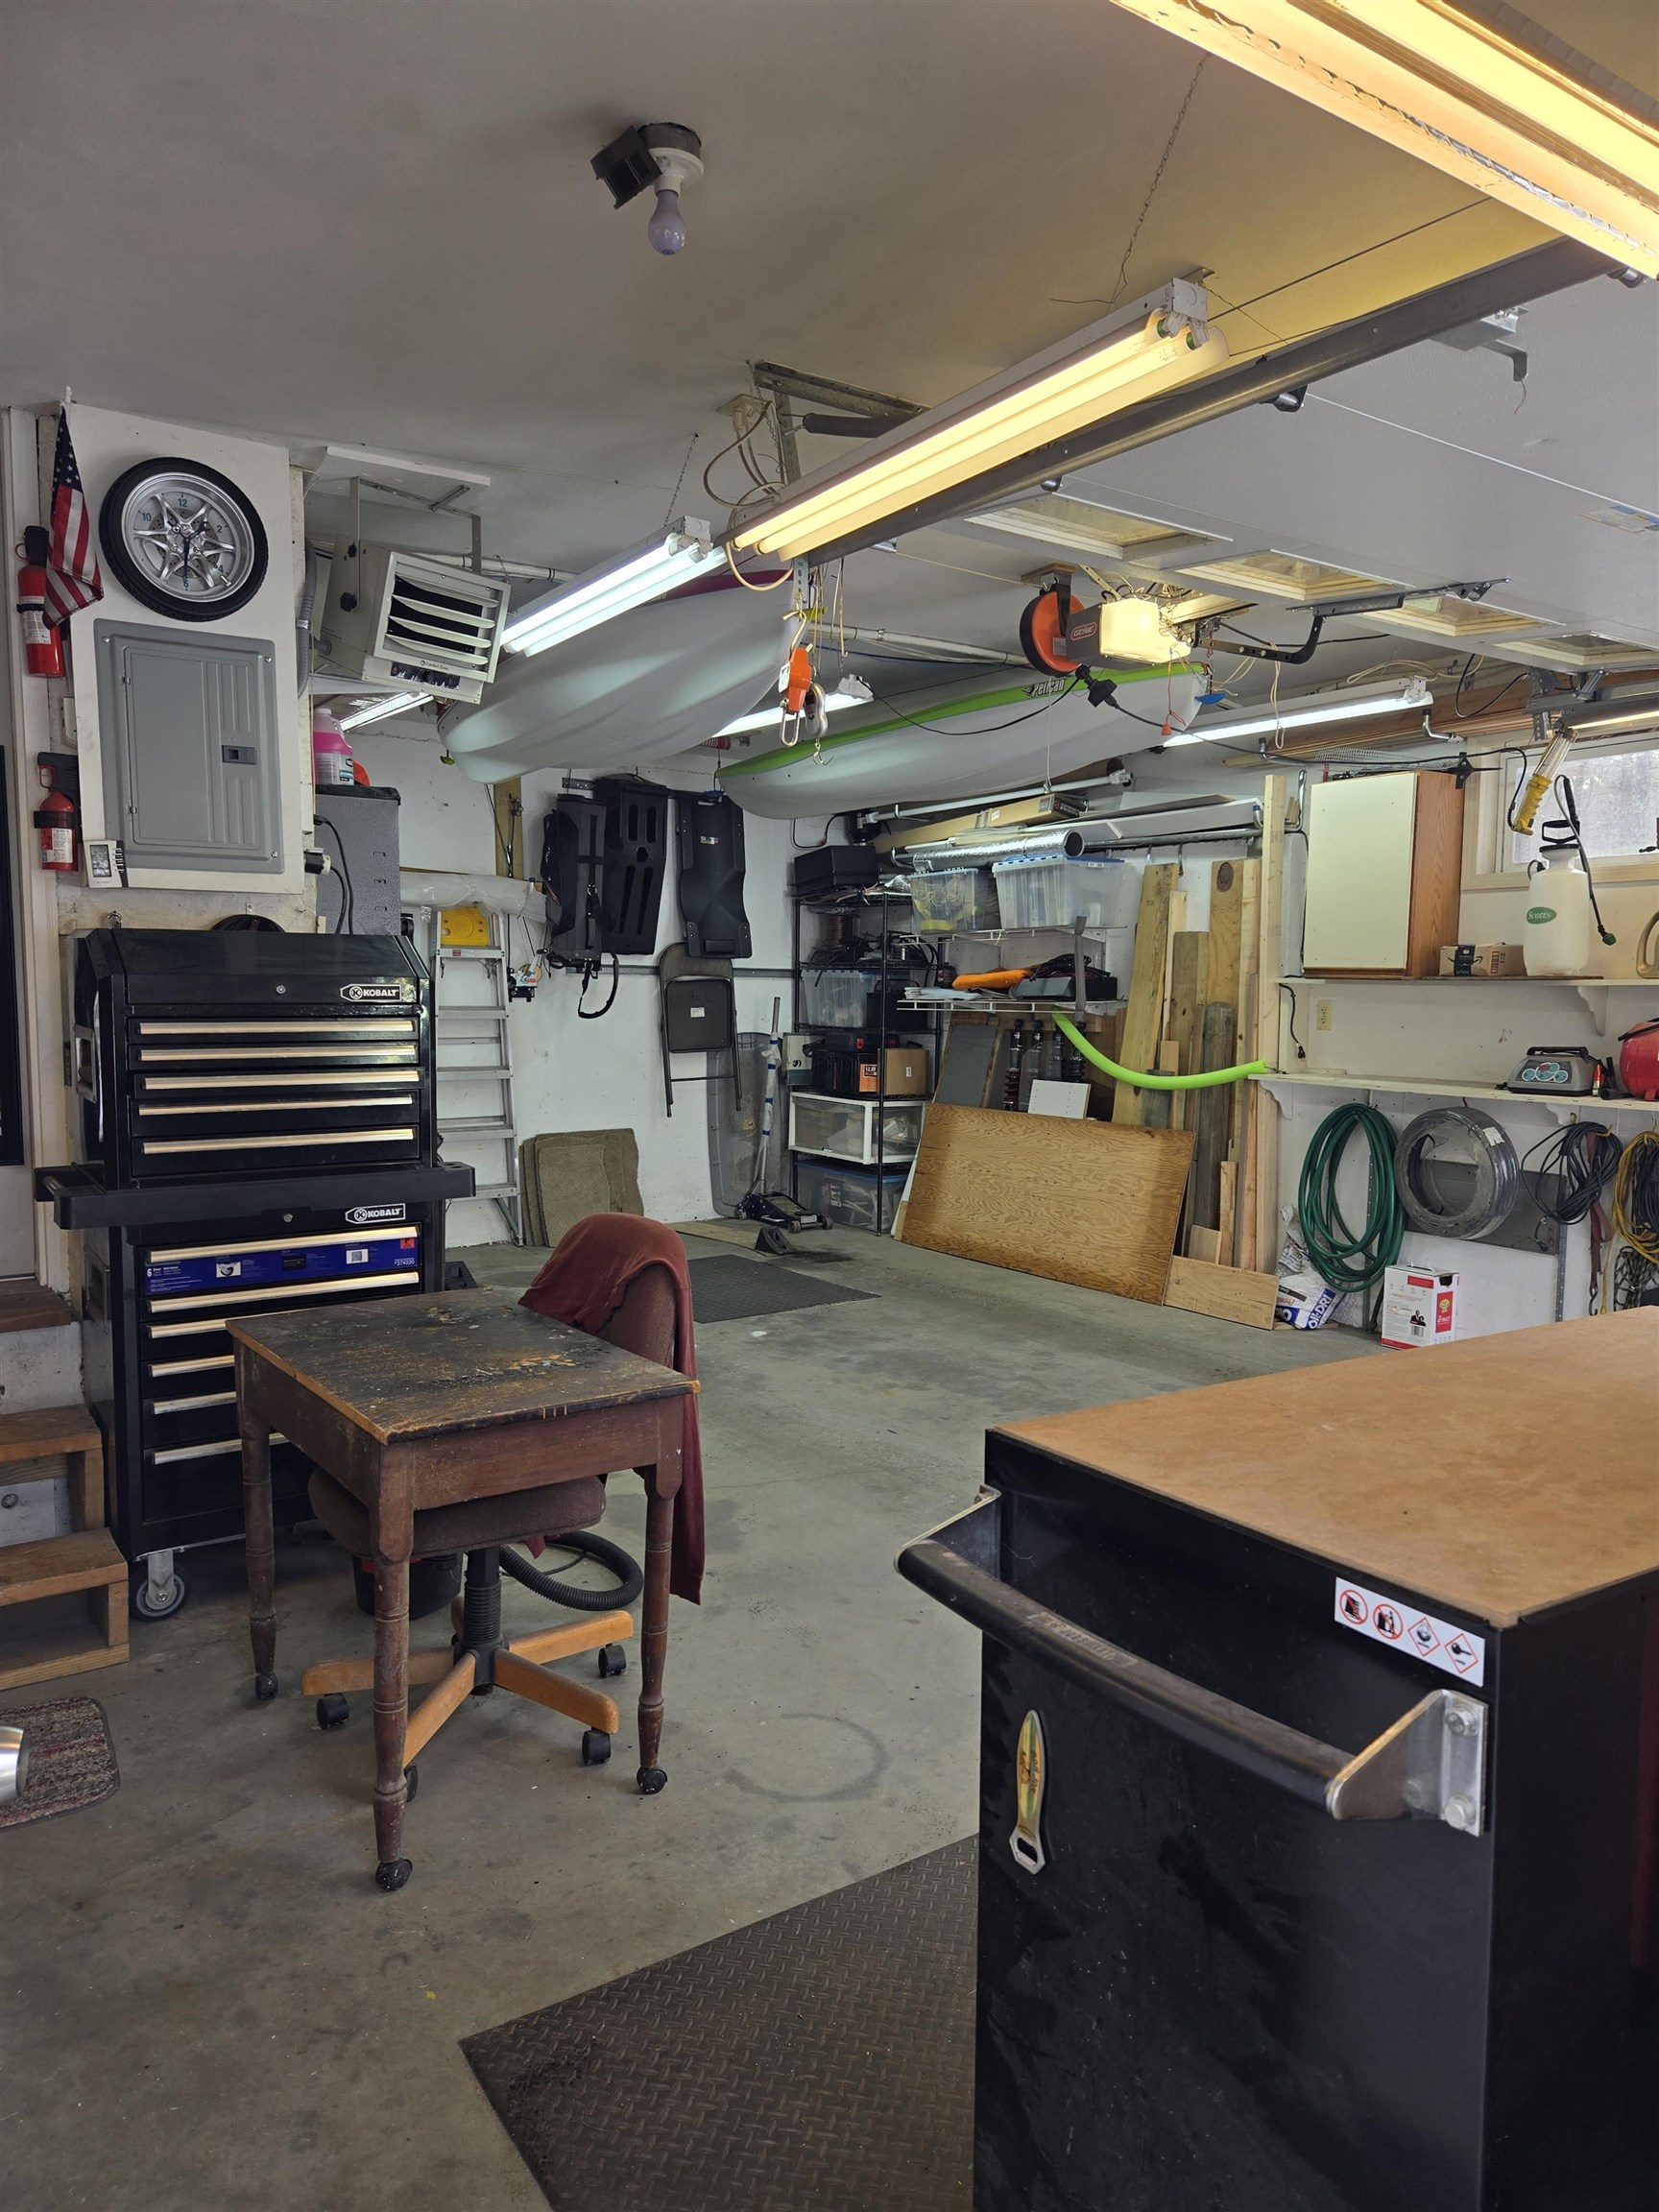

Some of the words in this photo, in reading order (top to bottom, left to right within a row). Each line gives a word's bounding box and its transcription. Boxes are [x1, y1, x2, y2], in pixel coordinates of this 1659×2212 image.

[178, 498, 188, 508] 12
[142, 512, 152, 521] 10
[217, 524, 223, 534] 2
[1073, 624, 1094, 637] GENIE
[1031, 678, 1066, 697] Pelican
[1528, 911, 1552, 920] Scotts
[367, 1208, 400, 1218] KOBALT
[147, 1267, 152, 1277] 6
